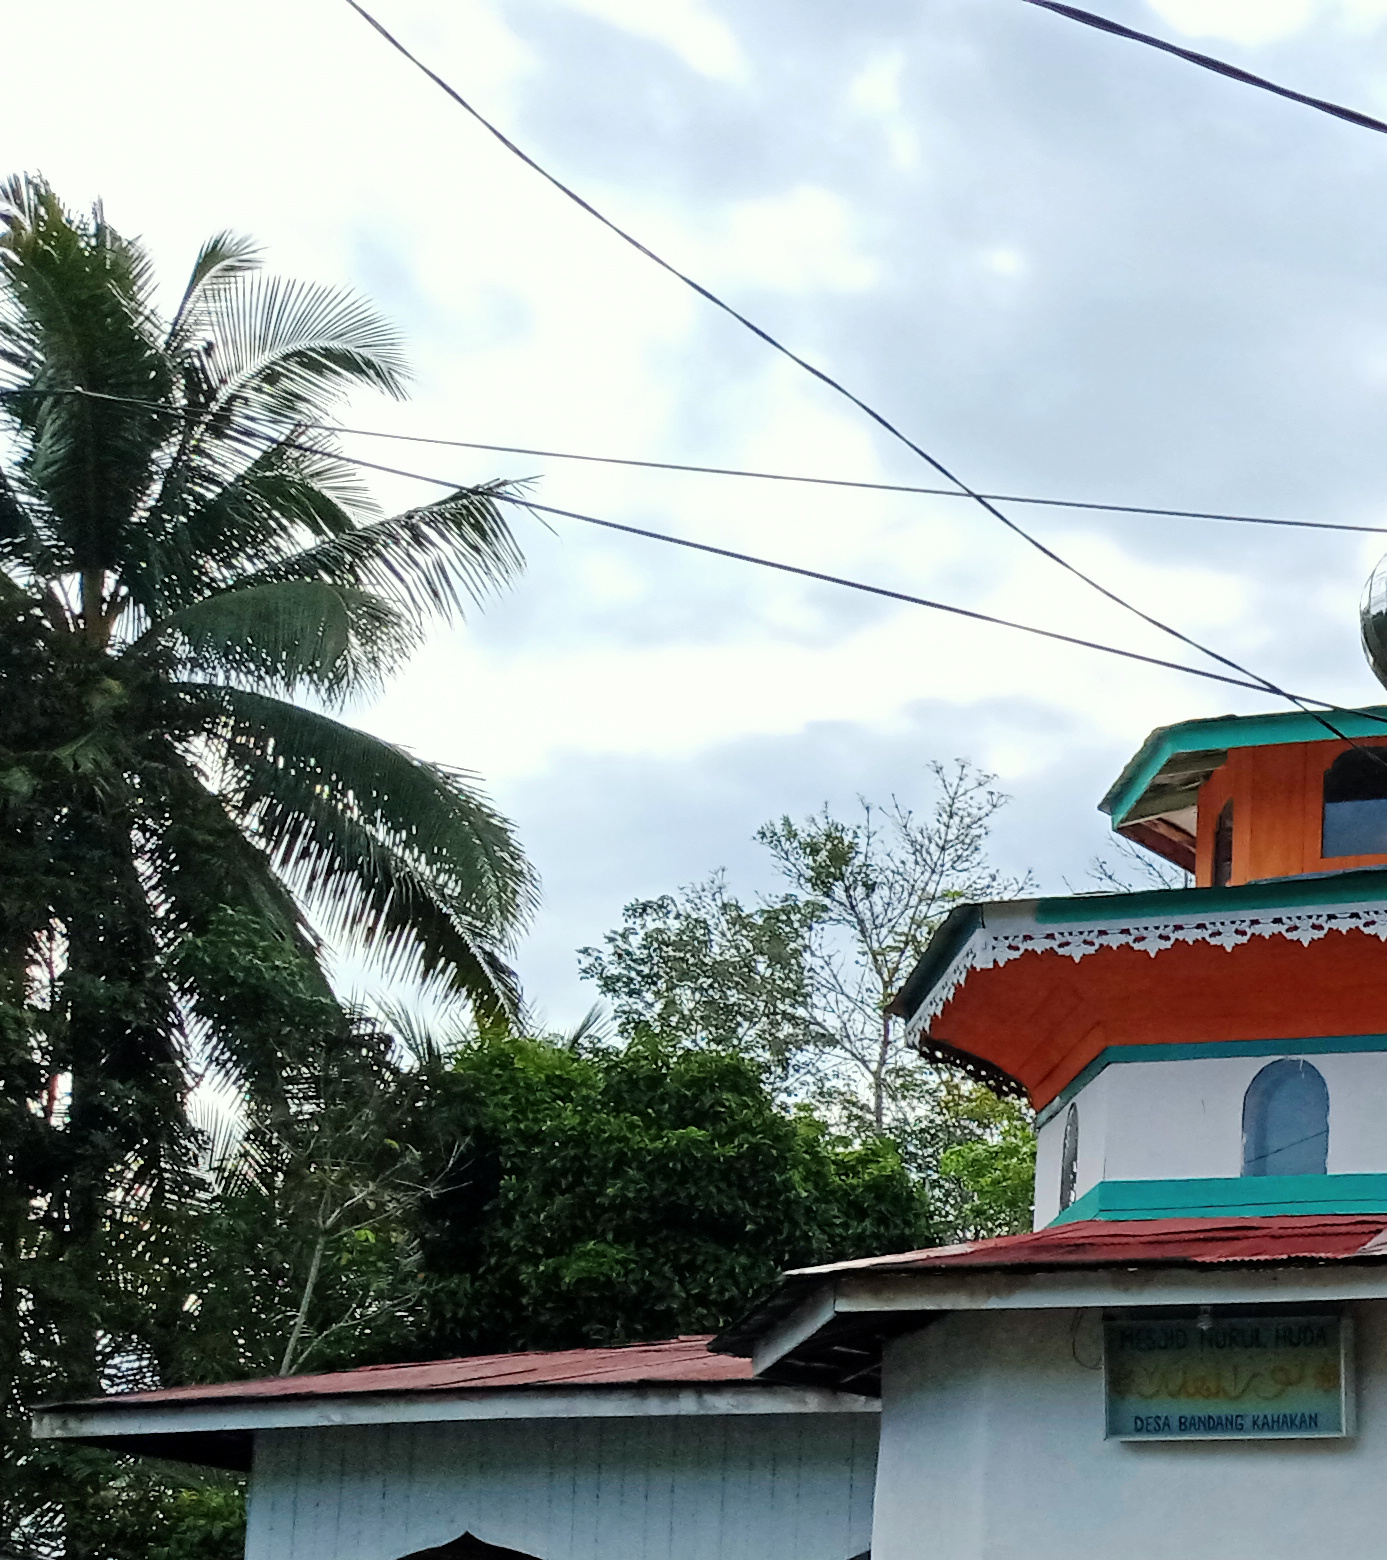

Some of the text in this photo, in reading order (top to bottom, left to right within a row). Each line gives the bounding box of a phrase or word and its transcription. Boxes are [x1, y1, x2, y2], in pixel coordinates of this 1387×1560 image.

[1120, 1324, 1327, 1351] MESJID NURUL HUDA
[1134, 1412, 1319, 1433] DESA BANDANG KAHAKAN
